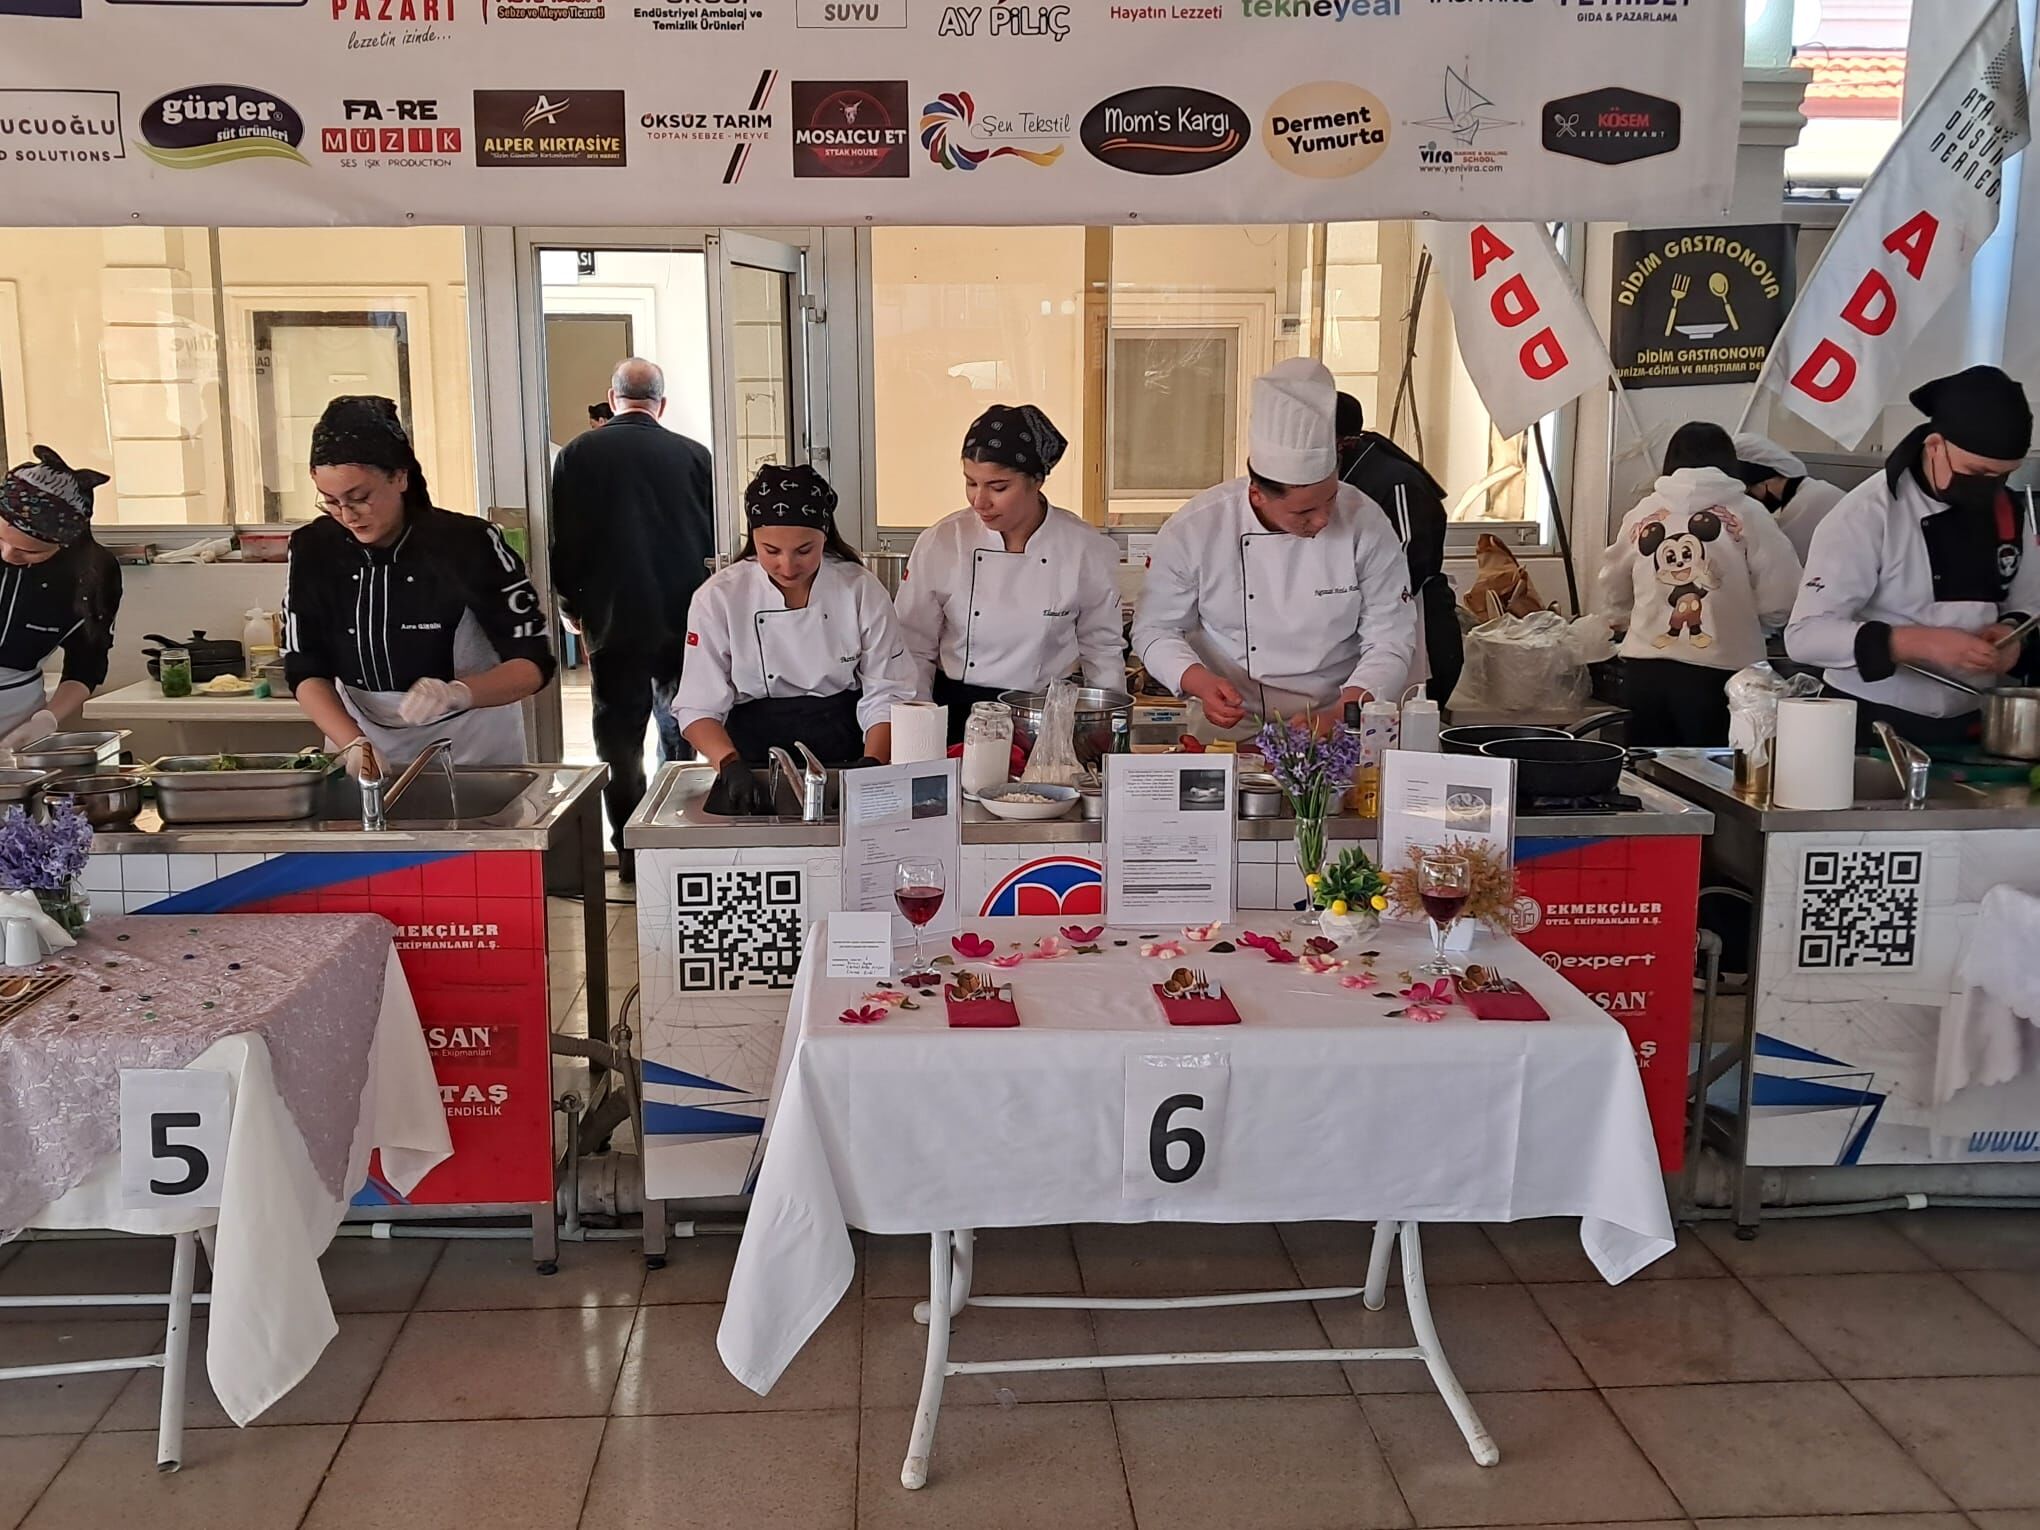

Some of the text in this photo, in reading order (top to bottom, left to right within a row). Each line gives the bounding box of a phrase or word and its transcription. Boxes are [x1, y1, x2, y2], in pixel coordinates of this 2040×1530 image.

[497, 6, 605, 22] Sebze ve Meyve Ticareti
[633, 7, 763, 20] Endüstriyel Ambalaj ve
[824, 4, 879, 22] SUYU
[1110, 5, 1223, 22] Hayatın Lezzeti
[1577, 12, 1678, 22] GIDA & PAZARLAMA
[653, 19, 745, 31] Temizlik Ürünleri
[938, 7, 982, 37] AY
[347, 30, 396, 50] lezzetin
[162, 95, 276, 125] gürler
[343, 100, 438, 120] FA-RE
[1598, 107, 1650, 127] KÖSEM
[640, 113, 772, 128] ÖKSÜZ TARIM
[981, 112, 1071, 136] Şen Tekstil
[1105, 107, 1171, 133] Mom's
[217, 126, 289, 142] süt ürünleri
[647, 132, 690, 140] TOPTAN
[692, 132, 724, 140] SEBZE
[734, 132, 769, 140] MEYVE
[796, 129, 907, 145] MOSAICU ET
[1272, 106, 1385, 154] Derment Yumurta
[484, 134, 620, 152] ALPER KIRTASİYE
[15, 150, 111, 163] SOLUTIONS
[825, 149, 878, 157] STEAK HOUSE
[1420, 141, 1453, 163] vira
[340, 159, 358, 168] SES
[388, 159, 452, 168] PRODUCTION
[1419, 164, 1503, 174] www.yenivira.com
[1618, 235, 1780, 306] DİDİM GASTRONOVA
[1790, 210, 1939, 403] ADD
[1637, 346, 1766, 364] DİDİM GASTRONOVA
[1682, 365, 1693, 374] VE
[1695, 362, 1746, 376] ARAŞTIRMA
[1547, 901, 1662, 917] EKMEKÇİLER
[1574, 917, 1640, 926] EKİPMANLARI
[477, 940, 500, 950] A.Ş.
[1587, 991, 1647, 1010] SAN
[422, 1027, 491, 1049] SAN
[442, 1049, 492, 1058] Ekipmanları
[1149, 1093, 1206, 1184] 6
[150, 1112, 209, 1196] 5
